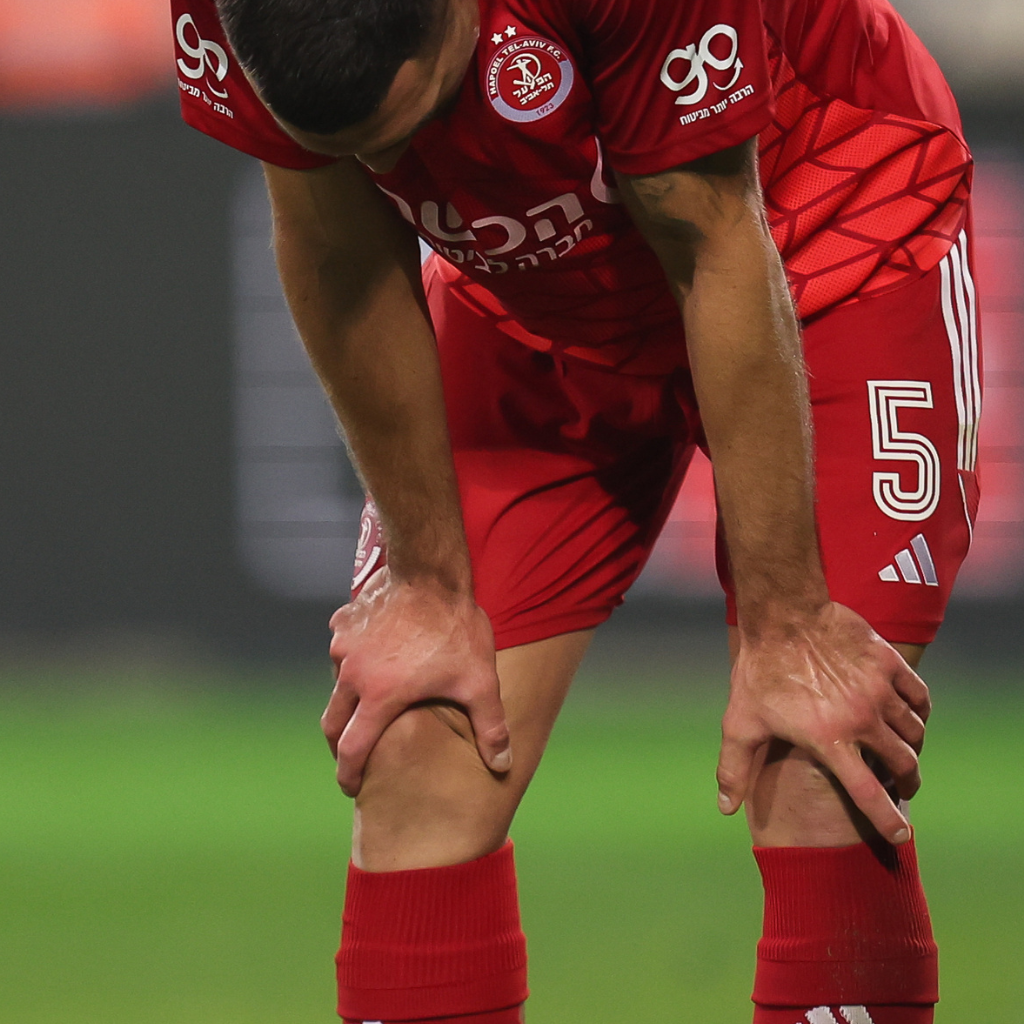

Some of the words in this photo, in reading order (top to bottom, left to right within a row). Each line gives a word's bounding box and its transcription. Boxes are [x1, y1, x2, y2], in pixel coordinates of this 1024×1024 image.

[489, 56, 504, 95] HAPOEL
[501, 40, 546, 56] TEL-AVIV
[546, 45, 561, 60] F.C.
[519, 81, 555, 105] תל-אביב
[728, 84, 755, 105] הרבה
[536, 102, 555, 116] 1923
[709, 98, 729, 114] יותר
[679, 108, 711, 126] מביטוח
[866, 379, 941, 522] 5
